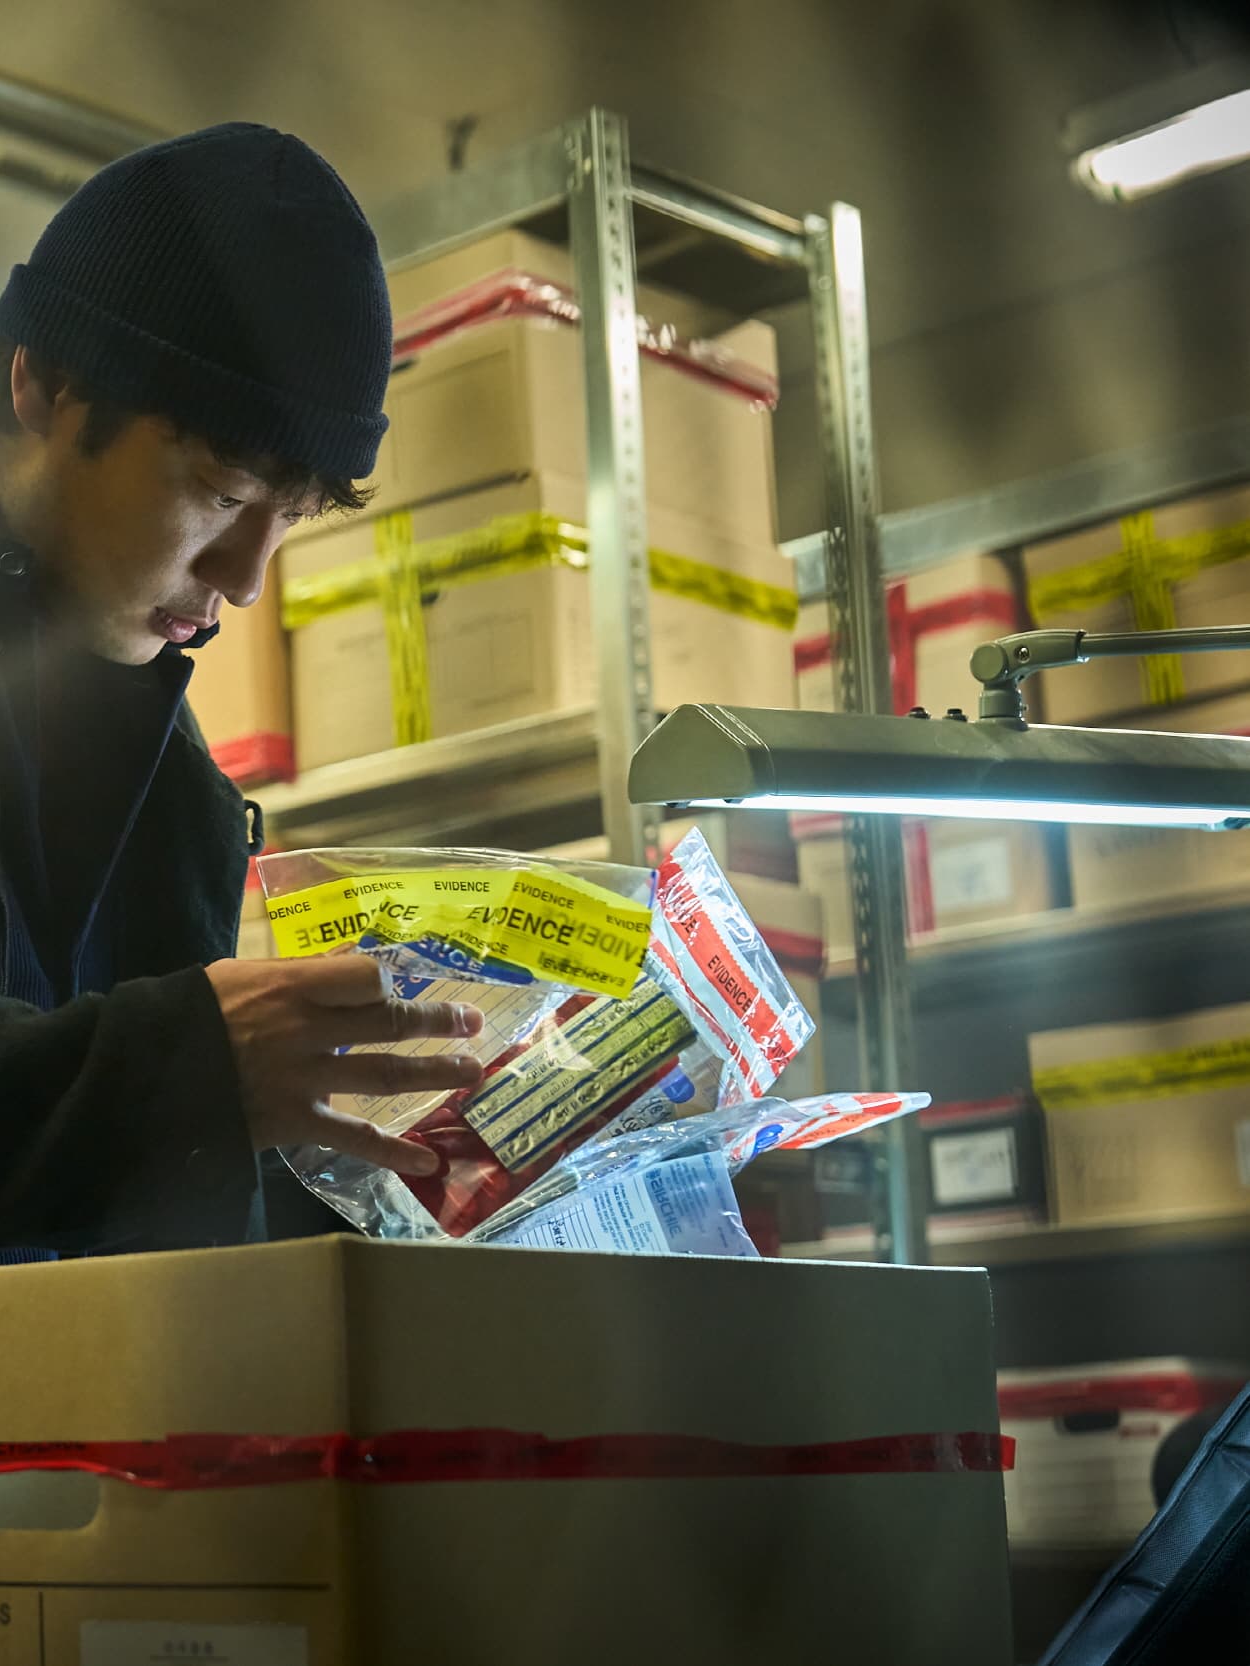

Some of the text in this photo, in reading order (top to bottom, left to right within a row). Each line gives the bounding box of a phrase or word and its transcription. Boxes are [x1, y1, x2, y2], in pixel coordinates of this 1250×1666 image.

[343, 881, 406, 900] EVIDENCE
[434, 880, 490, 893] EVIDENCE
[513, 881, 575, 910] EVIDENCE
[707, 954, 753, 1013] EVIDENCE
